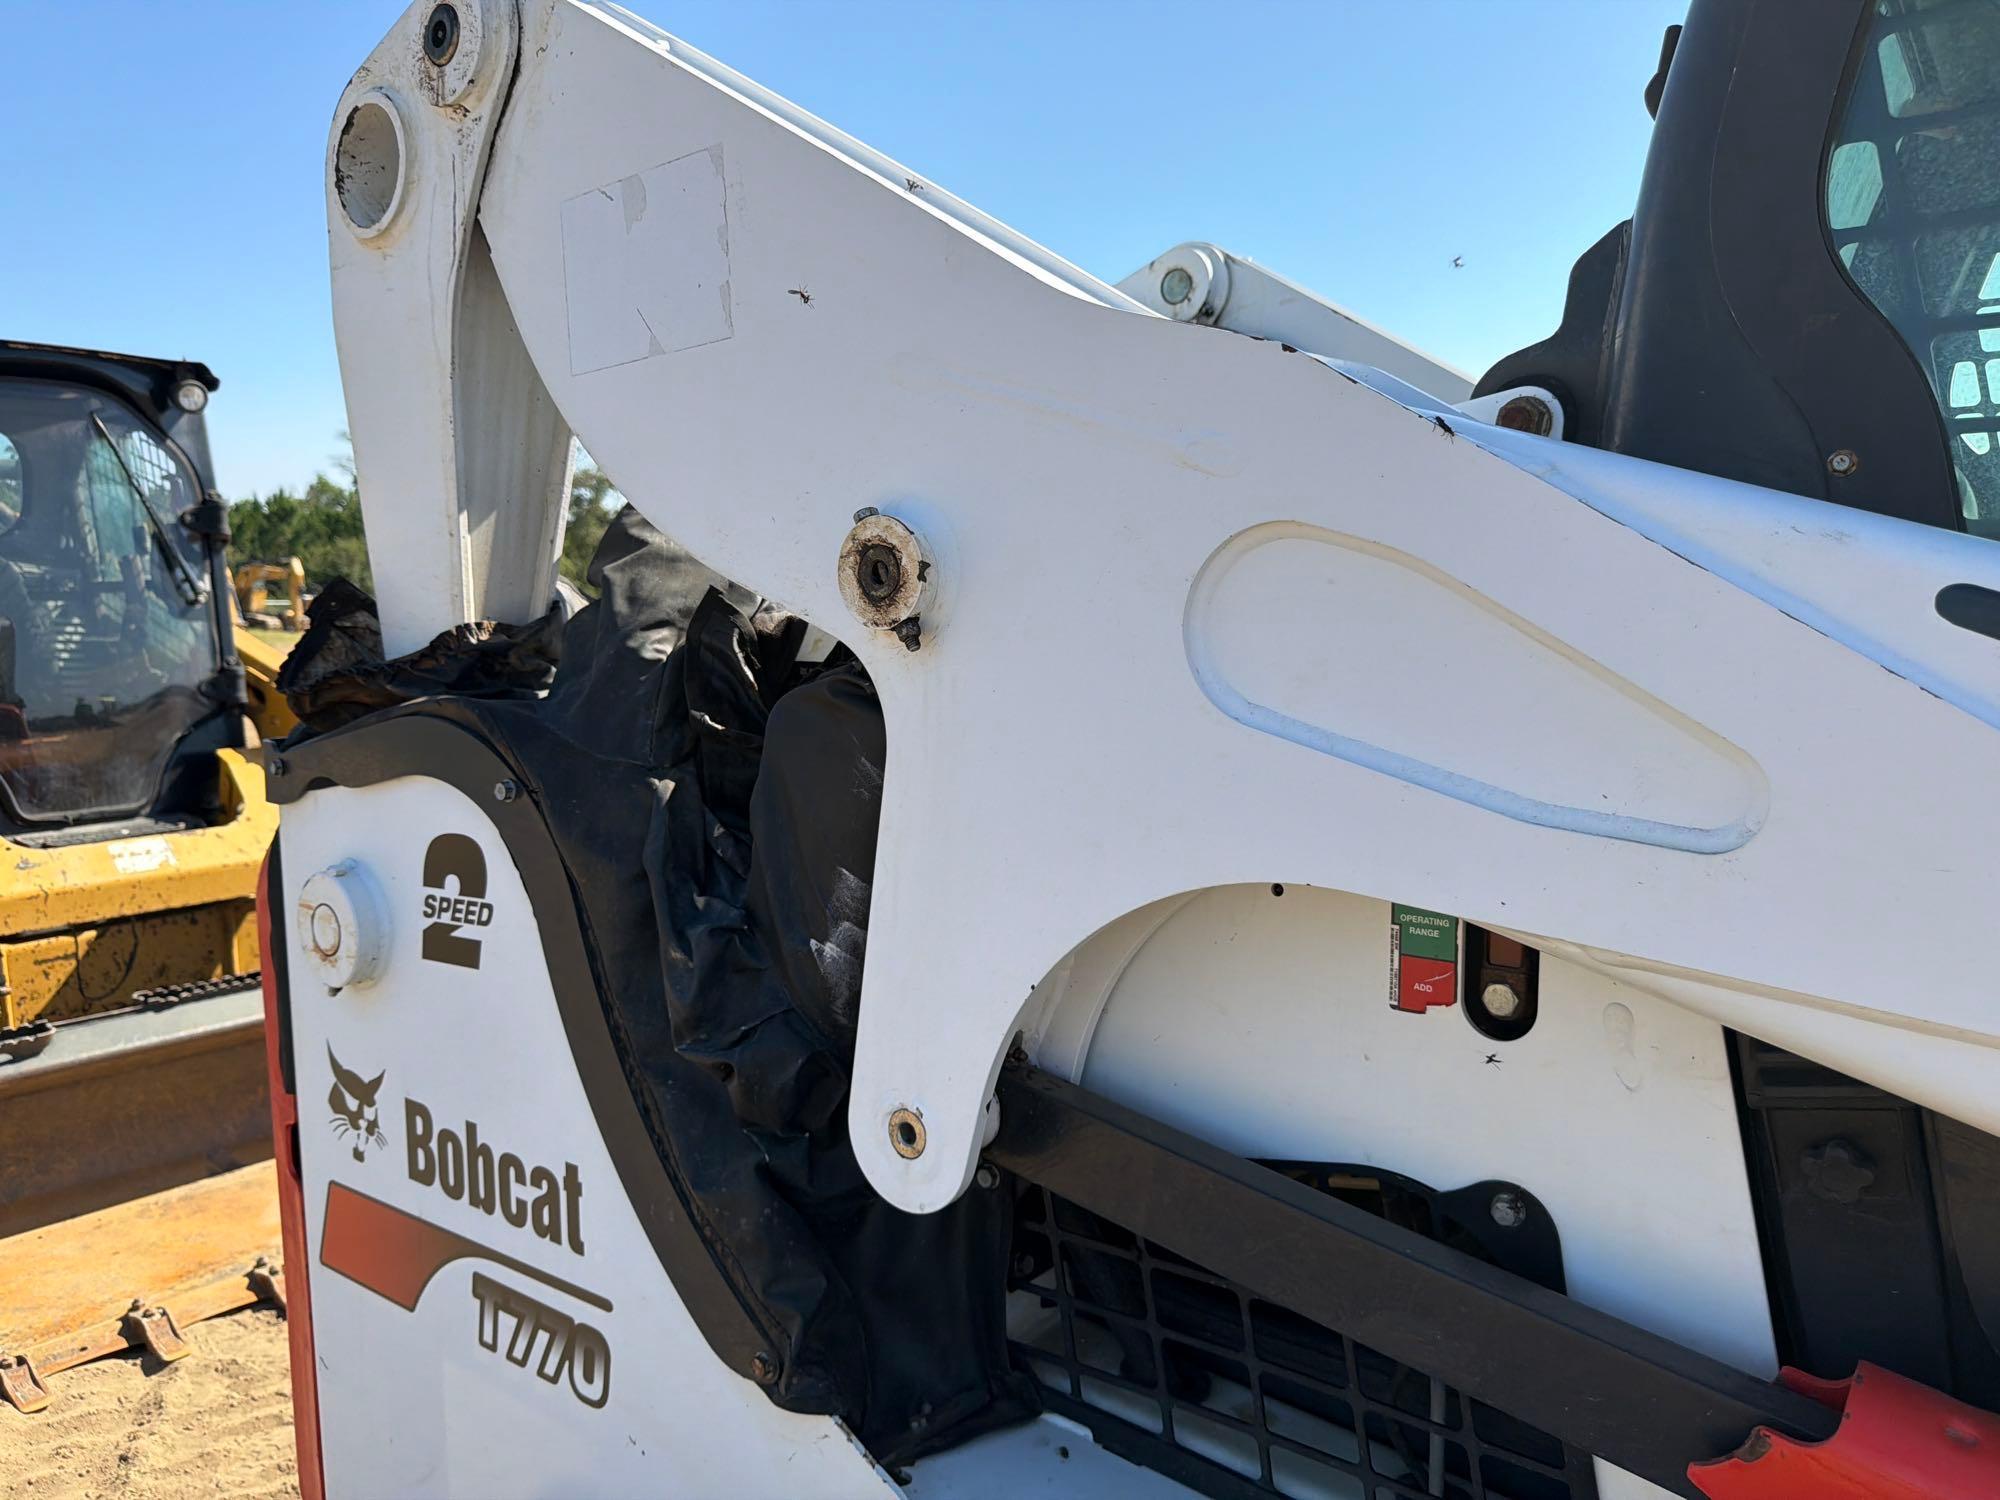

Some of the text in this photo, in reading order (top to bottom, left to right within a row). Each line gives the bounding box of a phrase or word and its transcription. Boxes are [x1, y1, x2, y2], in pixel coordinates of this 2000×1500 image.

[421, 832, 488, 970] 2
[422, 894, 494, 927] SPEED
[1400, 913, 1450, 928] OPERATING
[1409, 926, 1440, 938] RANGE
[1413, 982, 1433, 993] ADD
[404, 1096, 585, 1257] Bobcat
[472, 1271, 611, 1409] T770
